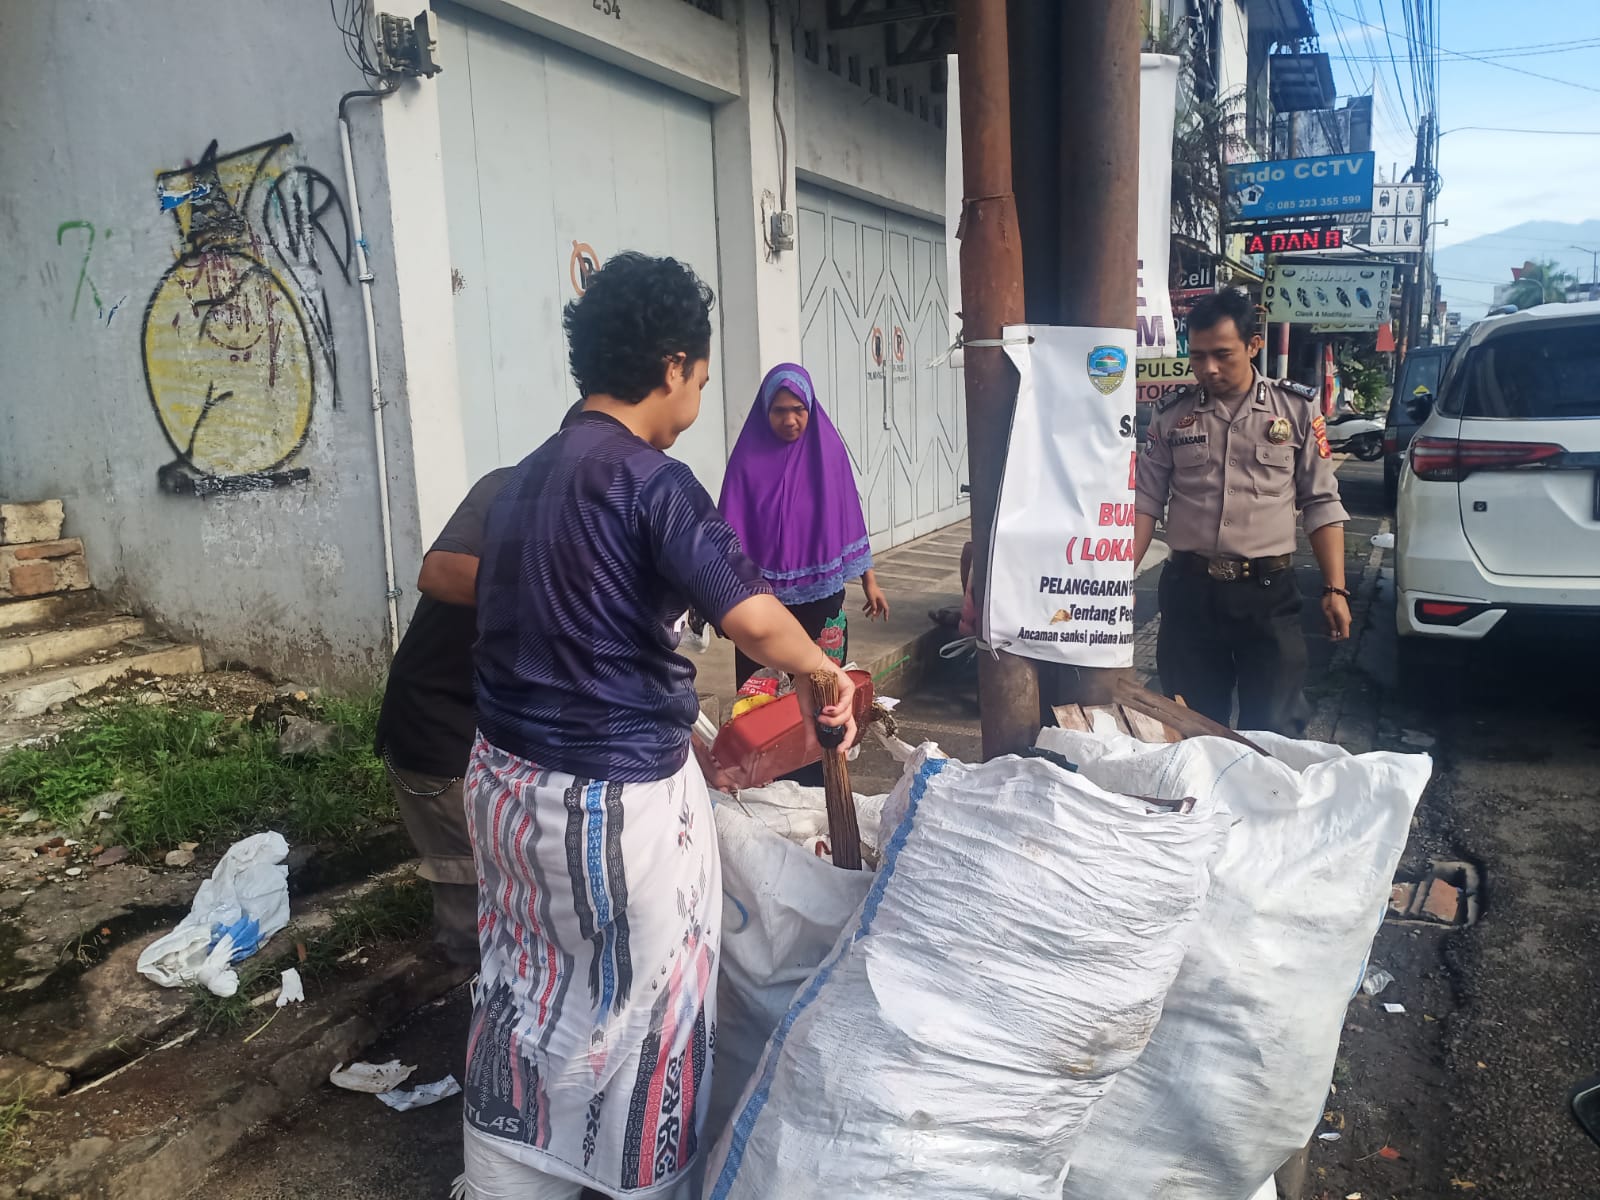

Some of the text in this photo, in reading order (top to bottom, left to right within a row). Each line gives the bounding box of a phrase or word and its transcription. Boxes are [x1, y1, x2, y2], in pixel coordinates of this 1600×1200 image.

[1294, 158, 1364, 180] CCTV
[1136, 384, 1180, 400] TOK
[1039, 576, 1129, 597] PELANGGARAN
[1070, 604, 1117, 626] Tentang
[1017, 627, 1059, 642] Ancaman
[1060, 630, 1088, 644] sanksi
[1089, 631, 1118, 647] pidana
[466, 1102, 521, 1134] TLAS
